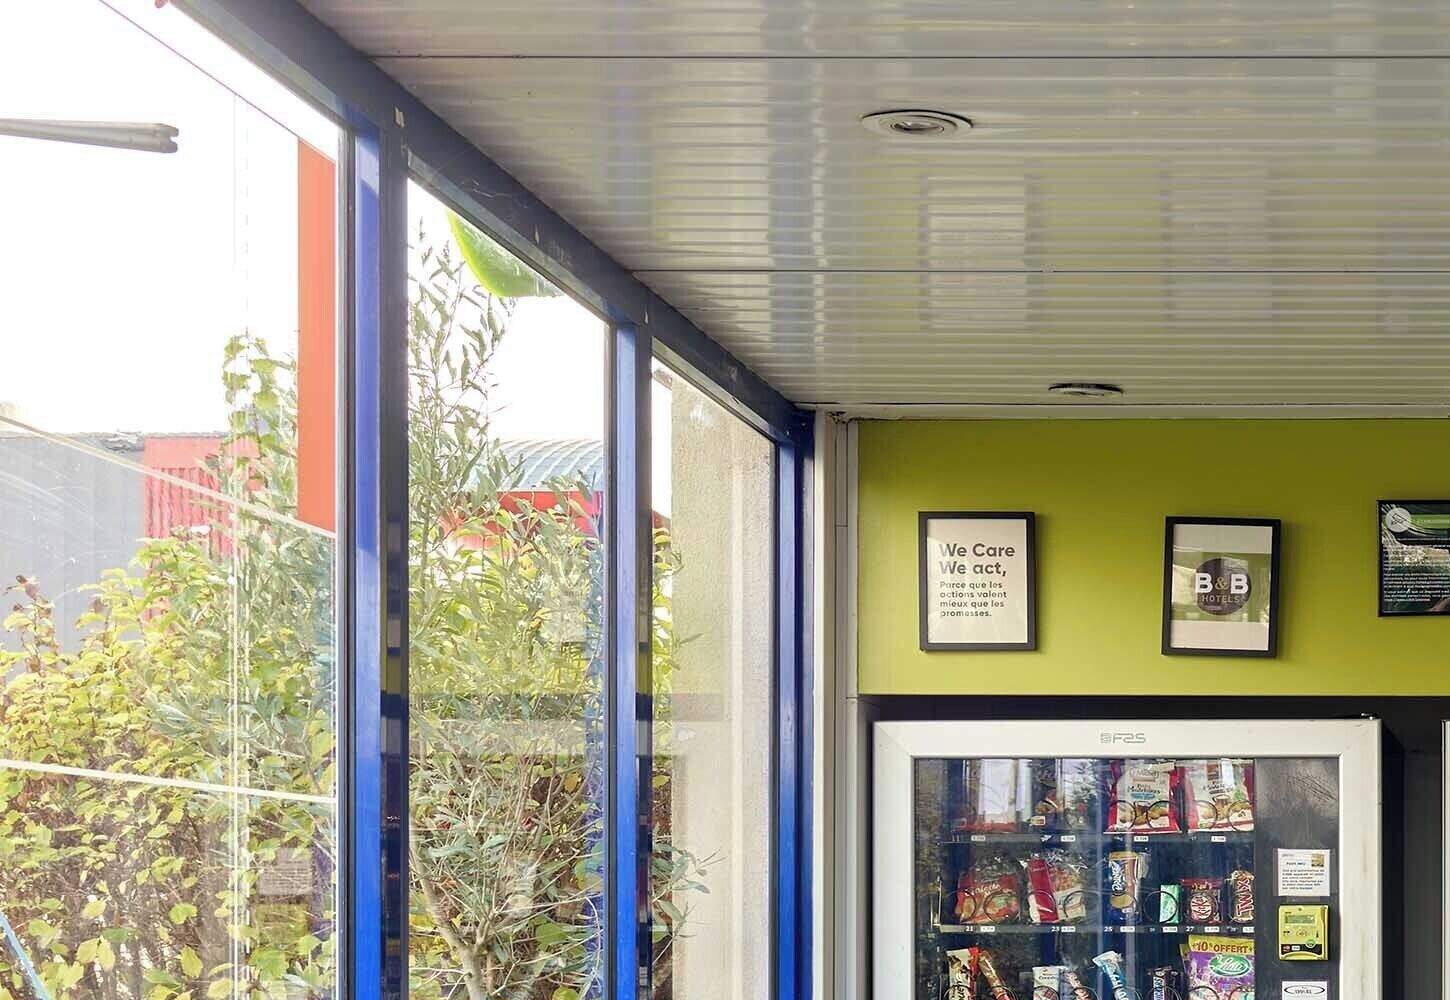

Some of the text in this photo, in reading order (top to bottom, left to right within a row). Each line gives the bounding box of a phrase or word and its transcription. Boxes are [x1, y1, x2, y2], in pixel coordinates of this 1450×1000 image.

[940, 543, 1016, 557] We Care
[940, 561, 1006, 577] We act,
[1195, 572, 1248, 594] B&B
[1202, 595, 1240, 603] HOTELS
[1214, 944, 1249, 953] OFFERT
